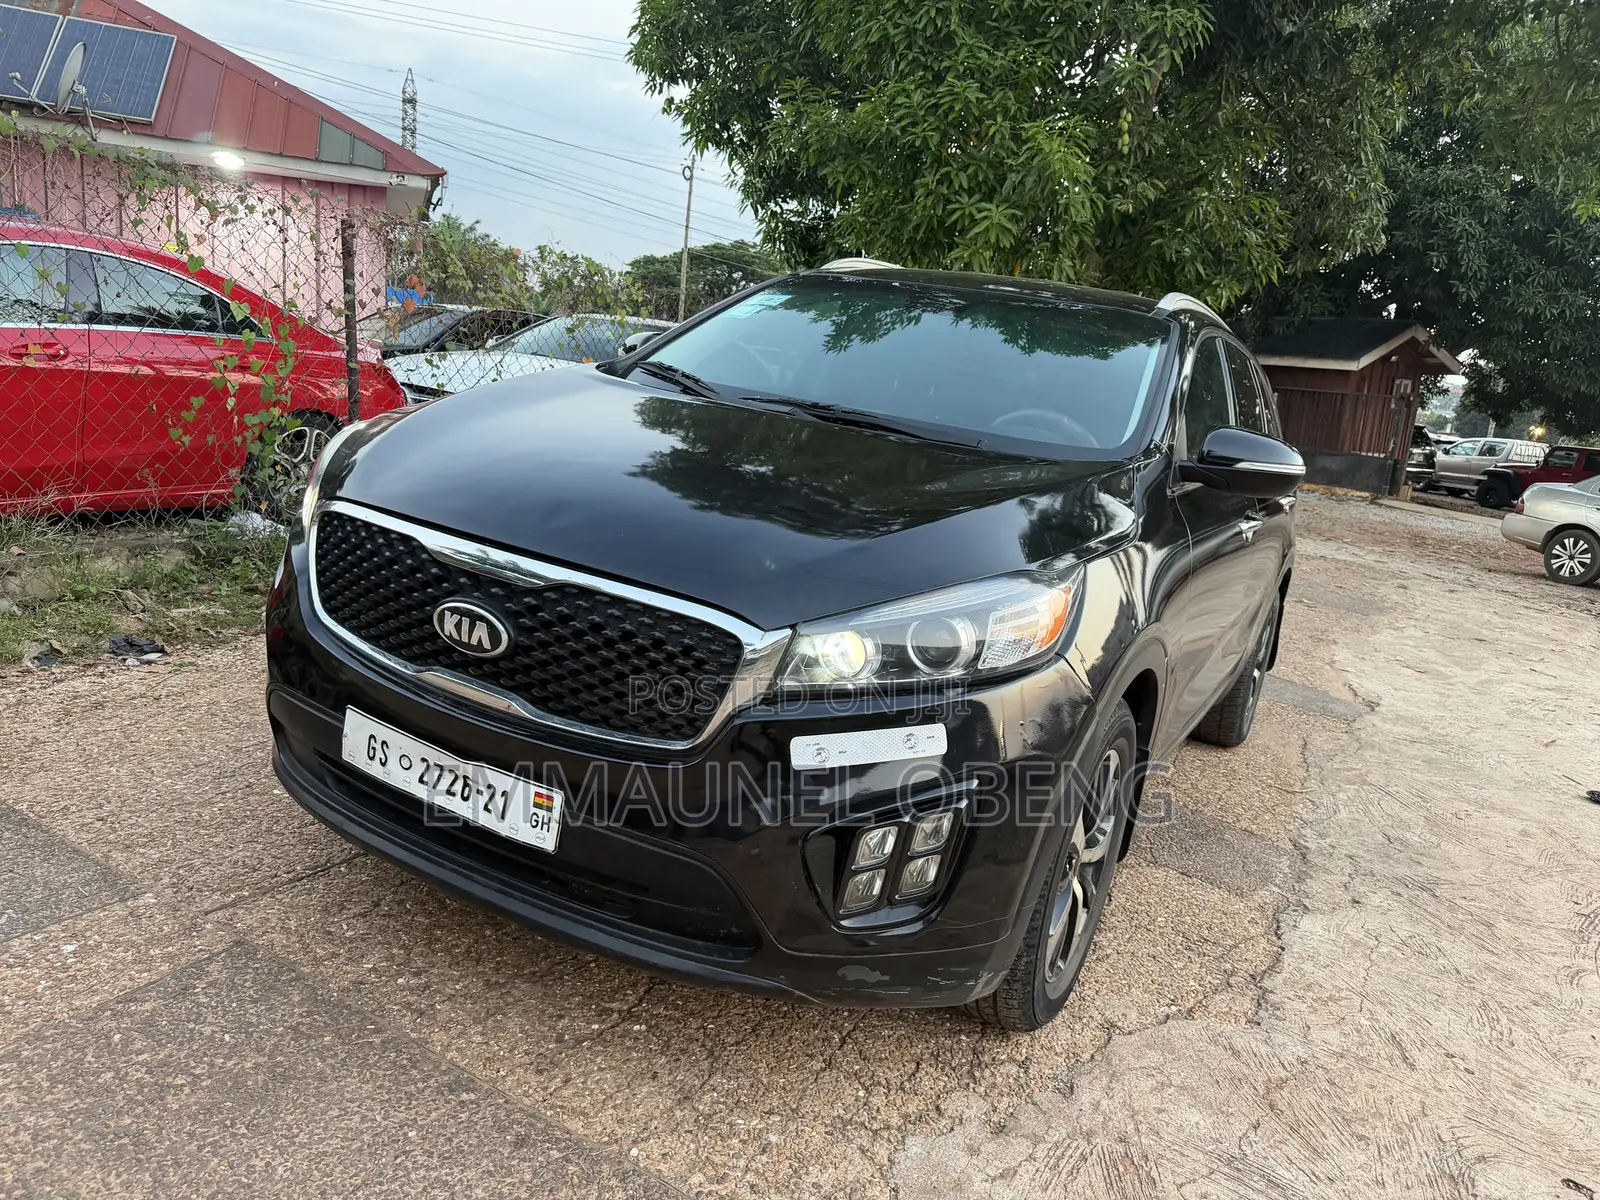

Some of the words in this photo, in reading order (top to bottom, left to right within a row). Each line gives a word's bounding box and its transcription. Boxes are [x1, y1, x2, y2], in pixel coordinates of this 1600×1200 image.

[444, 609, 492, 650] KIA
[366, 733, 390, 767] GS
[417, 756, 510, 821] 2726-21
[529, 811, 552, 833] GH
